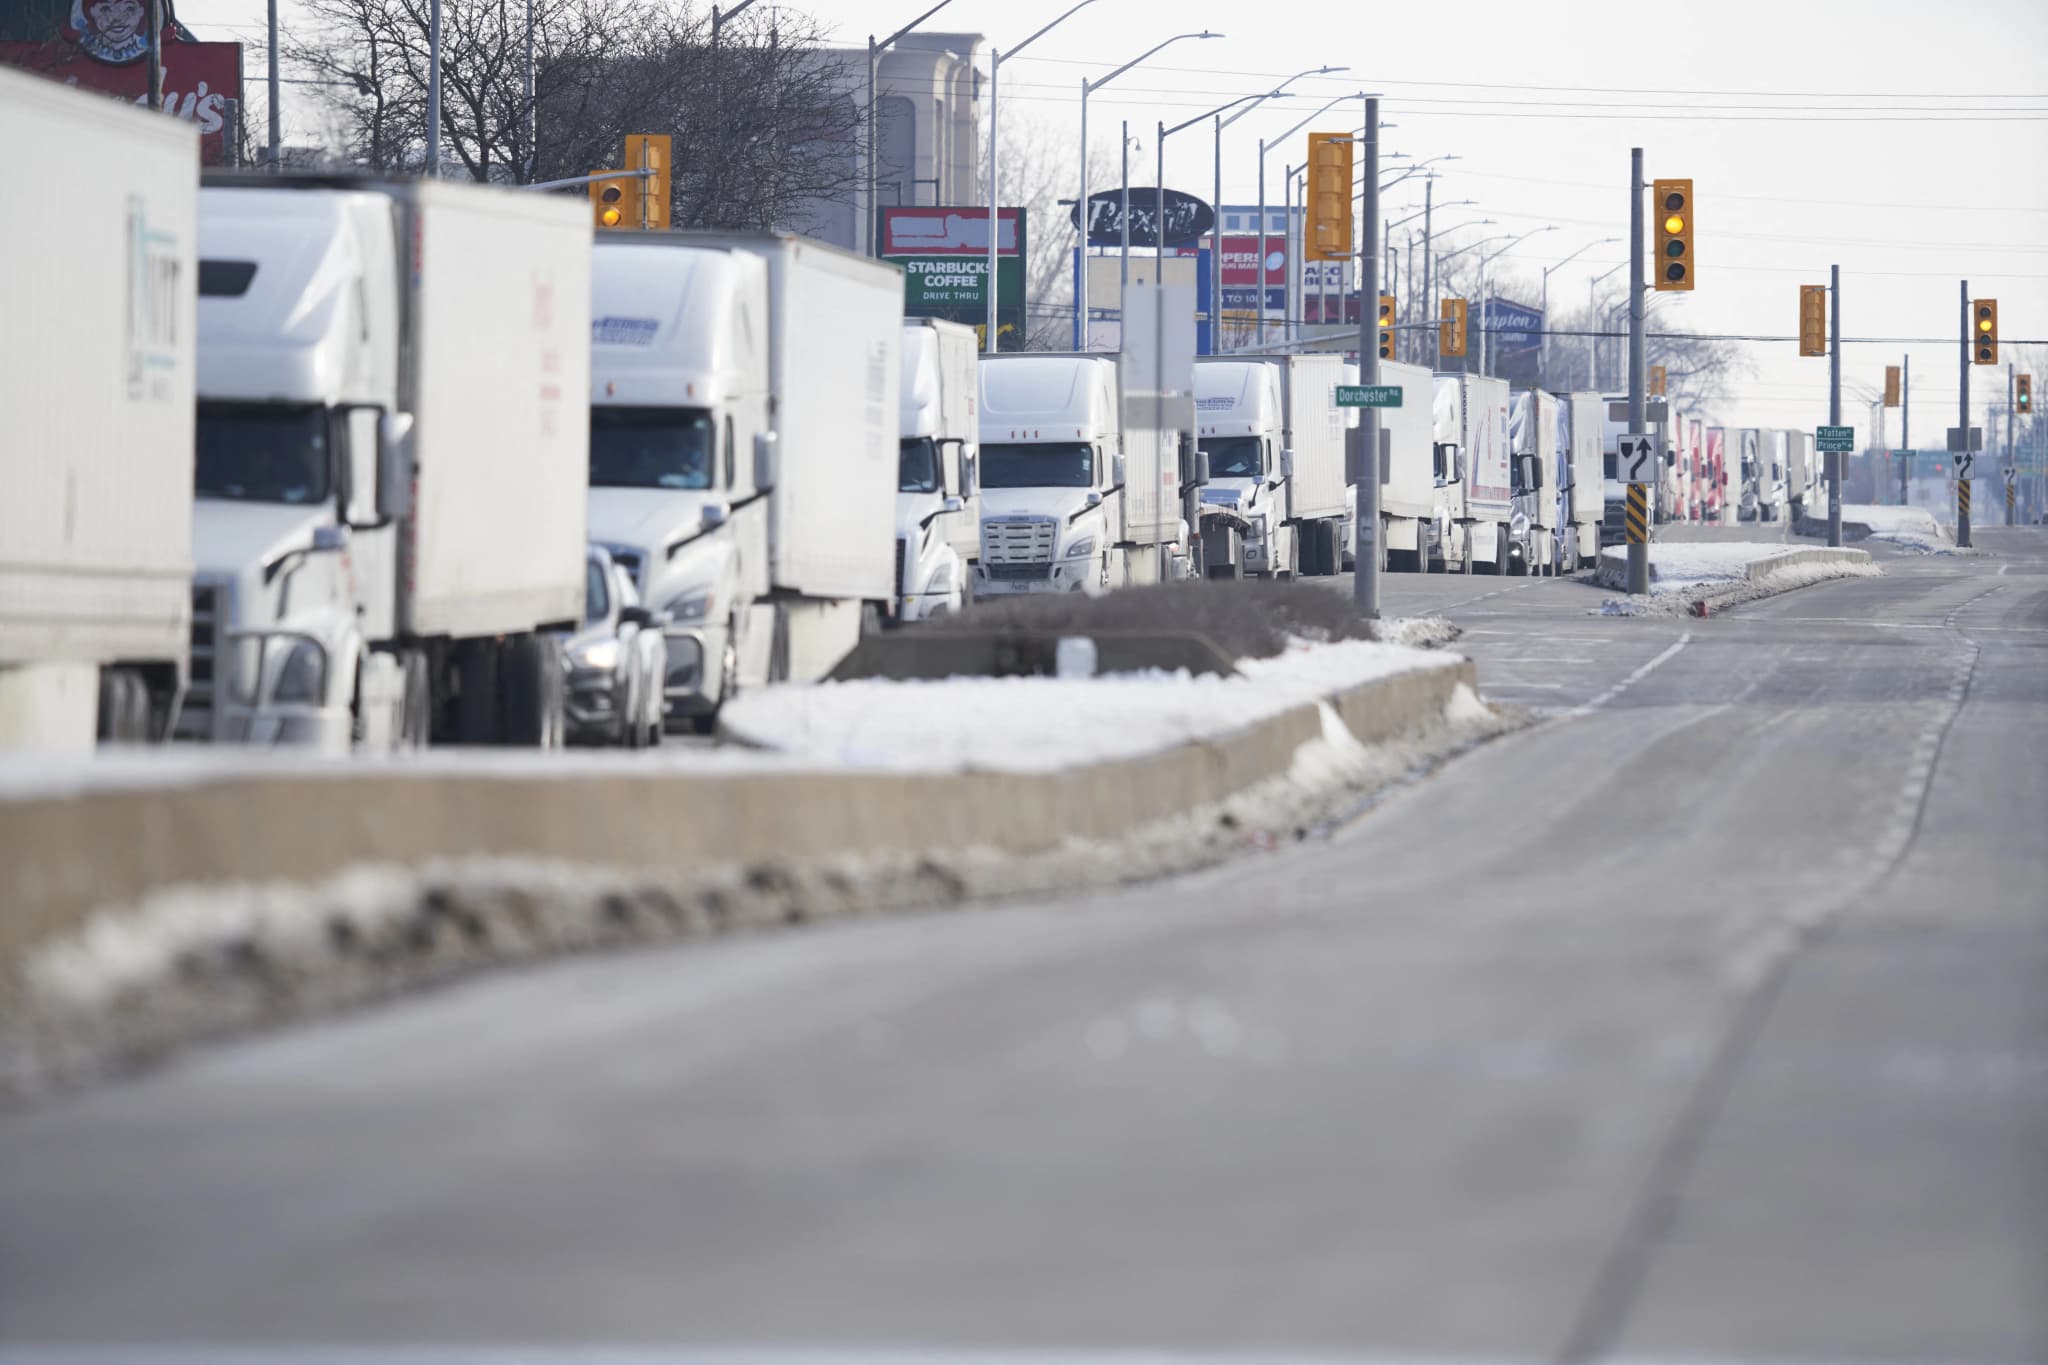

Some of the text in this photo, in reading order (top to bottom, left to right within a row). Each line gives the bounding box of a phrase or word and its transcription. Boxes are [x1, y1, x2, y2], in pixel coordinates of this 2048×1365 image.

[924, 275, 978, 287] COFFEE
[923, 292, 979, 300] DRIVE THRU
[1226, 295, 1241, 303] TO
[1339, 389, 1388, 403] Dorchester
[1823, 429, 1847, 437] Totten
[1818, 440, 1842, 450] Prince
